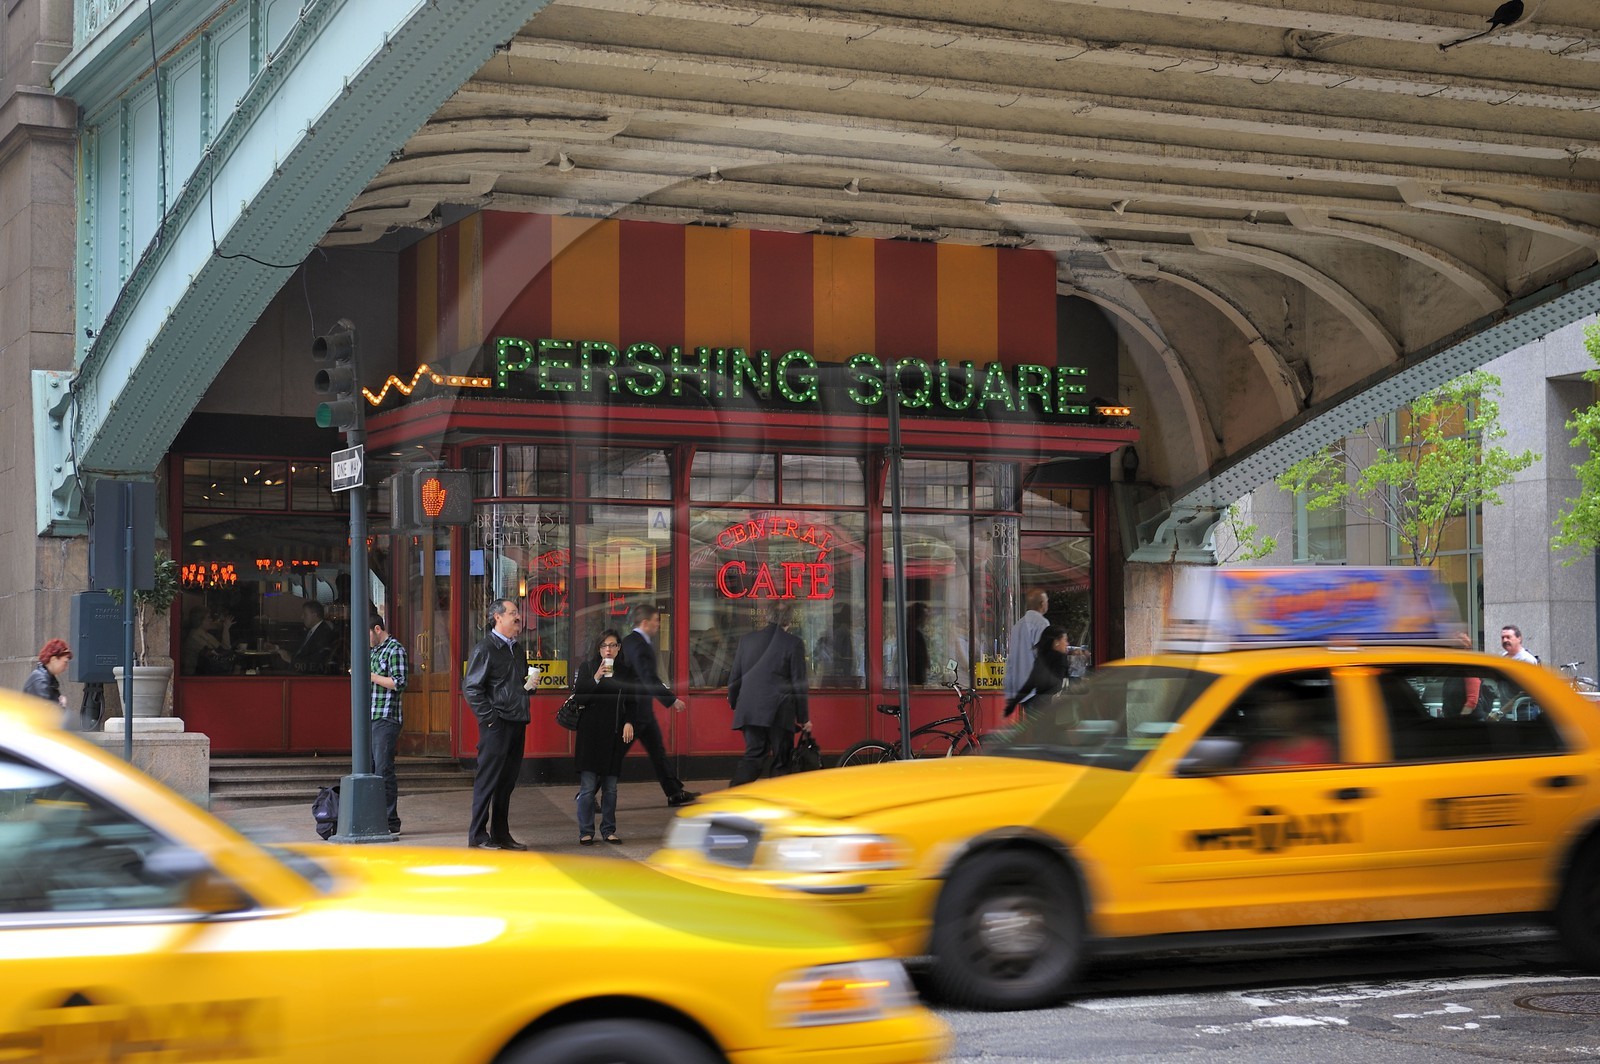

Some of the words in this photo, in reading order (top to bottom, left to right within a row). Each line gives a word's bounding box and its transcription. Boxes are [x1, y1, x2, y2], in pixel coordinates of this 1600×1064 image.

[493, 337, 819, 402] PERSHING
[848, 353, 1089, 415] SQUARE
[337, 462, 347, 478] ONE
[350, 459, 359, 475] WAY
[653, 511, 667, 529] A
[484, 531, 551, 547] CENTRAL
[716, 517, 834, 552] CENTRAL
[717, 551, 835, 600] CAFÉ
